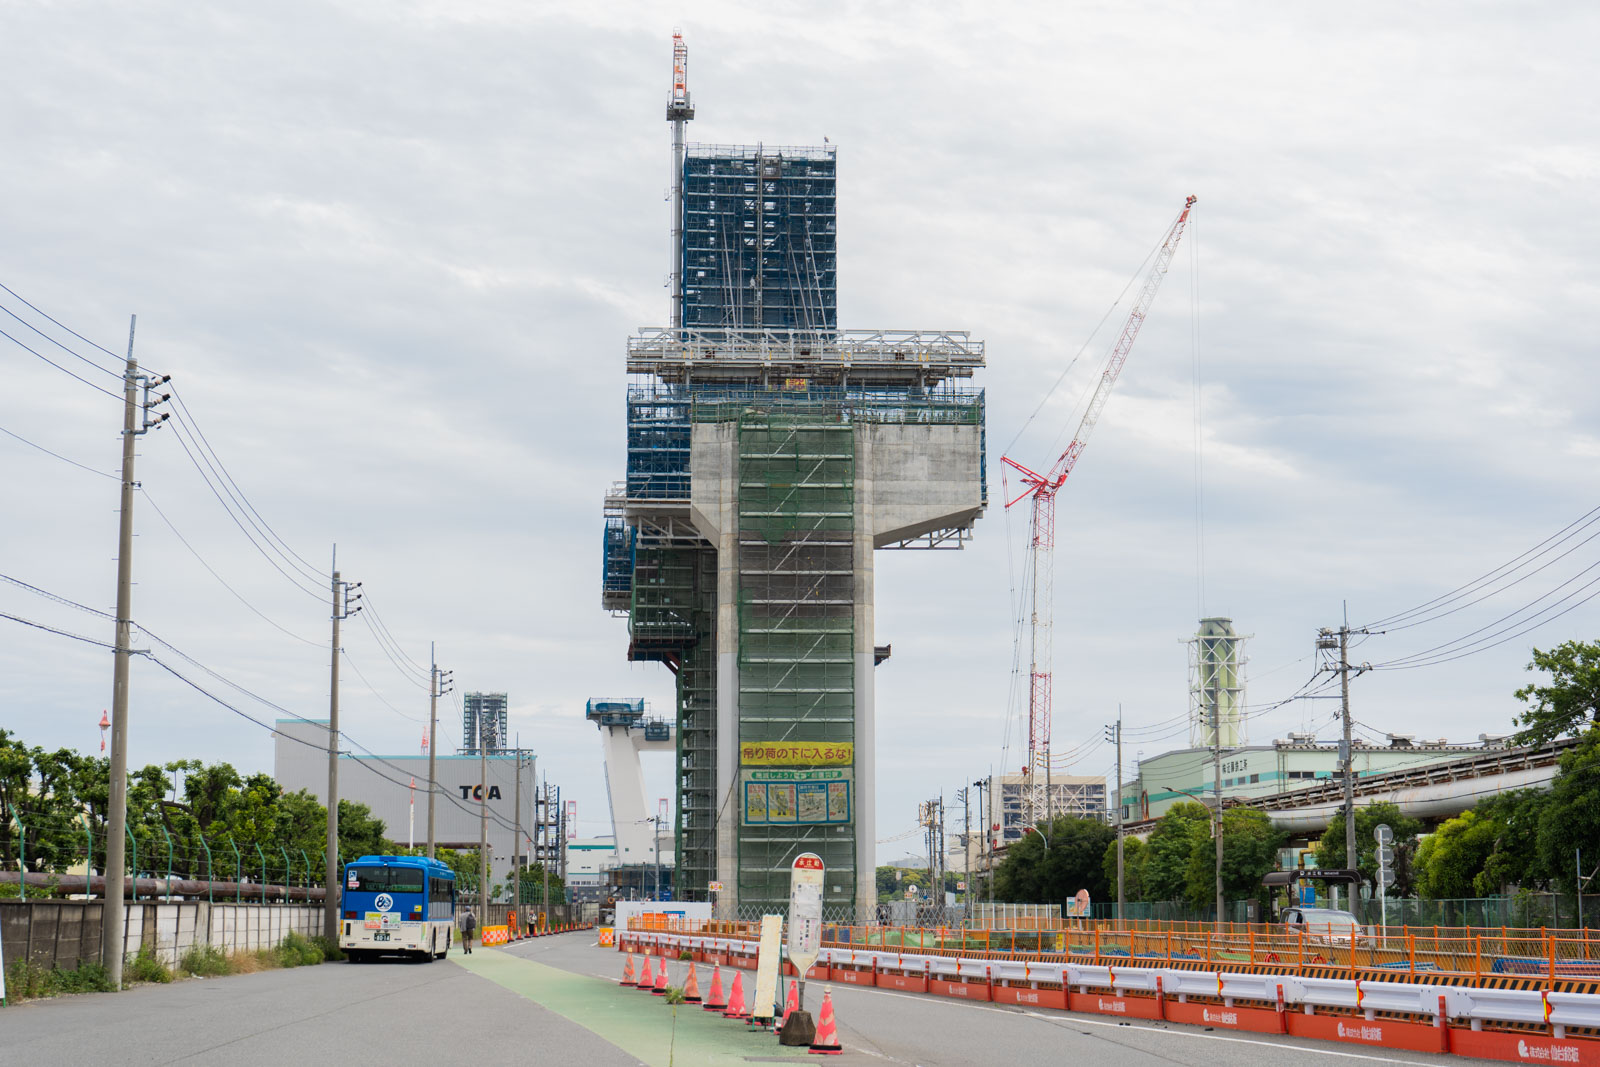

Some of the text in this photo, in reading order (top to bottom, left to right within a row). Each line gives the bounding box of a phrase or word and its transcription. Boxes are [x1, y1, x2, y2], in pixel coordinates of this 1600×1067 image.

[743, 747, 851, 760] 吊り荷の下に入るな!
[459, 784, 501, 802] TOA
